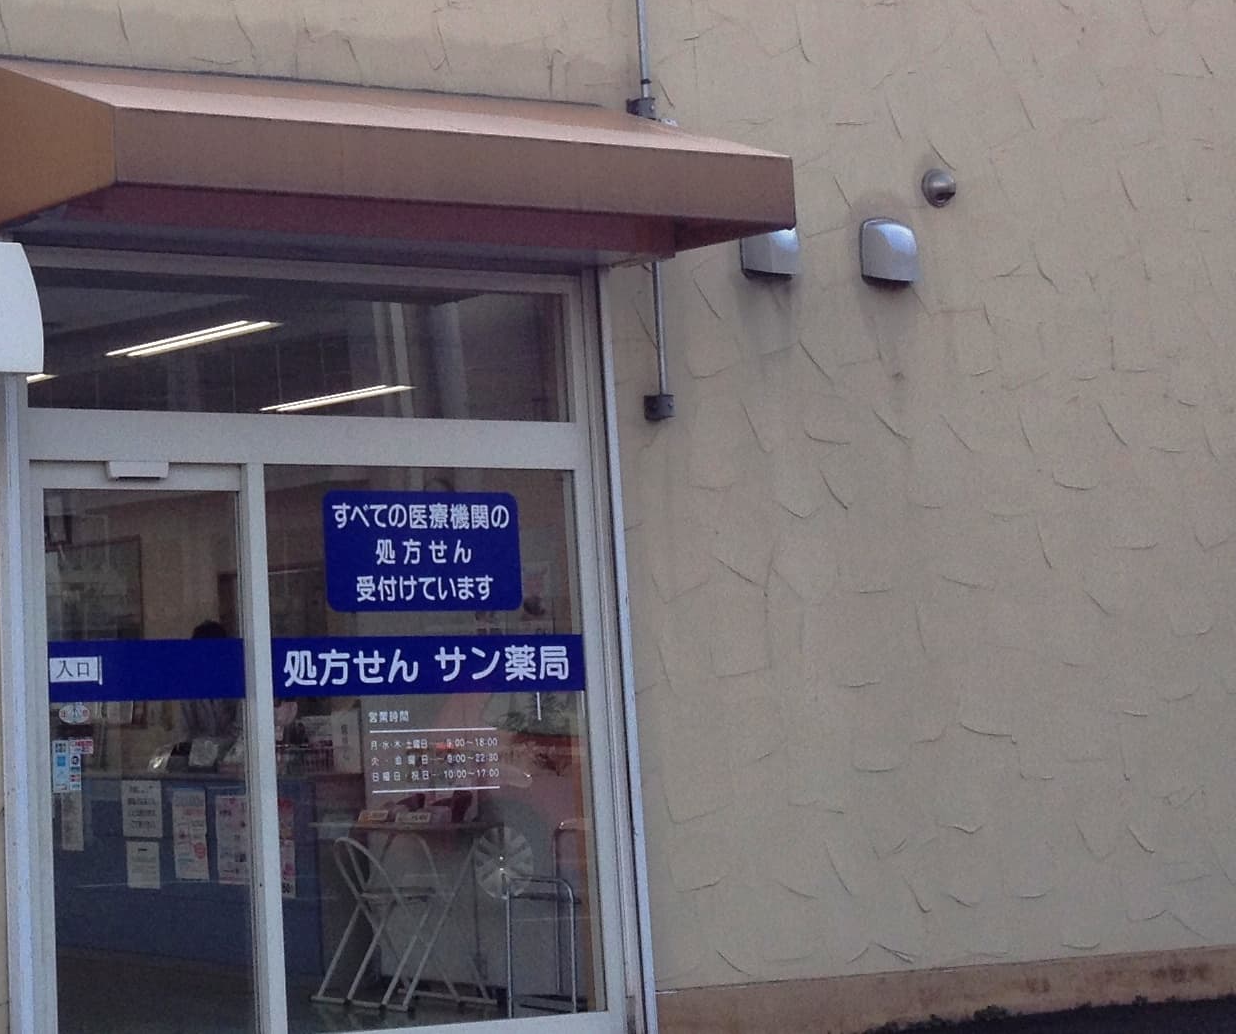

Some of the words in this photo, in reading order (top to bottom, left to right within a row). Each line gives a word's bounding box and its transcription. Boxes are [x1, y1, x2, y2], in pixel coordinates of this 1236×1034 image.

[332, 502, 510, 529] すべての医療機関の
[375, 538, 472, 565] 処方せん
[356, 574, 494, 602] 受付けています
[56, 660, 90, 678] 入口
[284, 648, 419, 687] 処方せん
[435, 644, 570, 682] サン薬局
[368, 710, 409, 723] 営業時間
